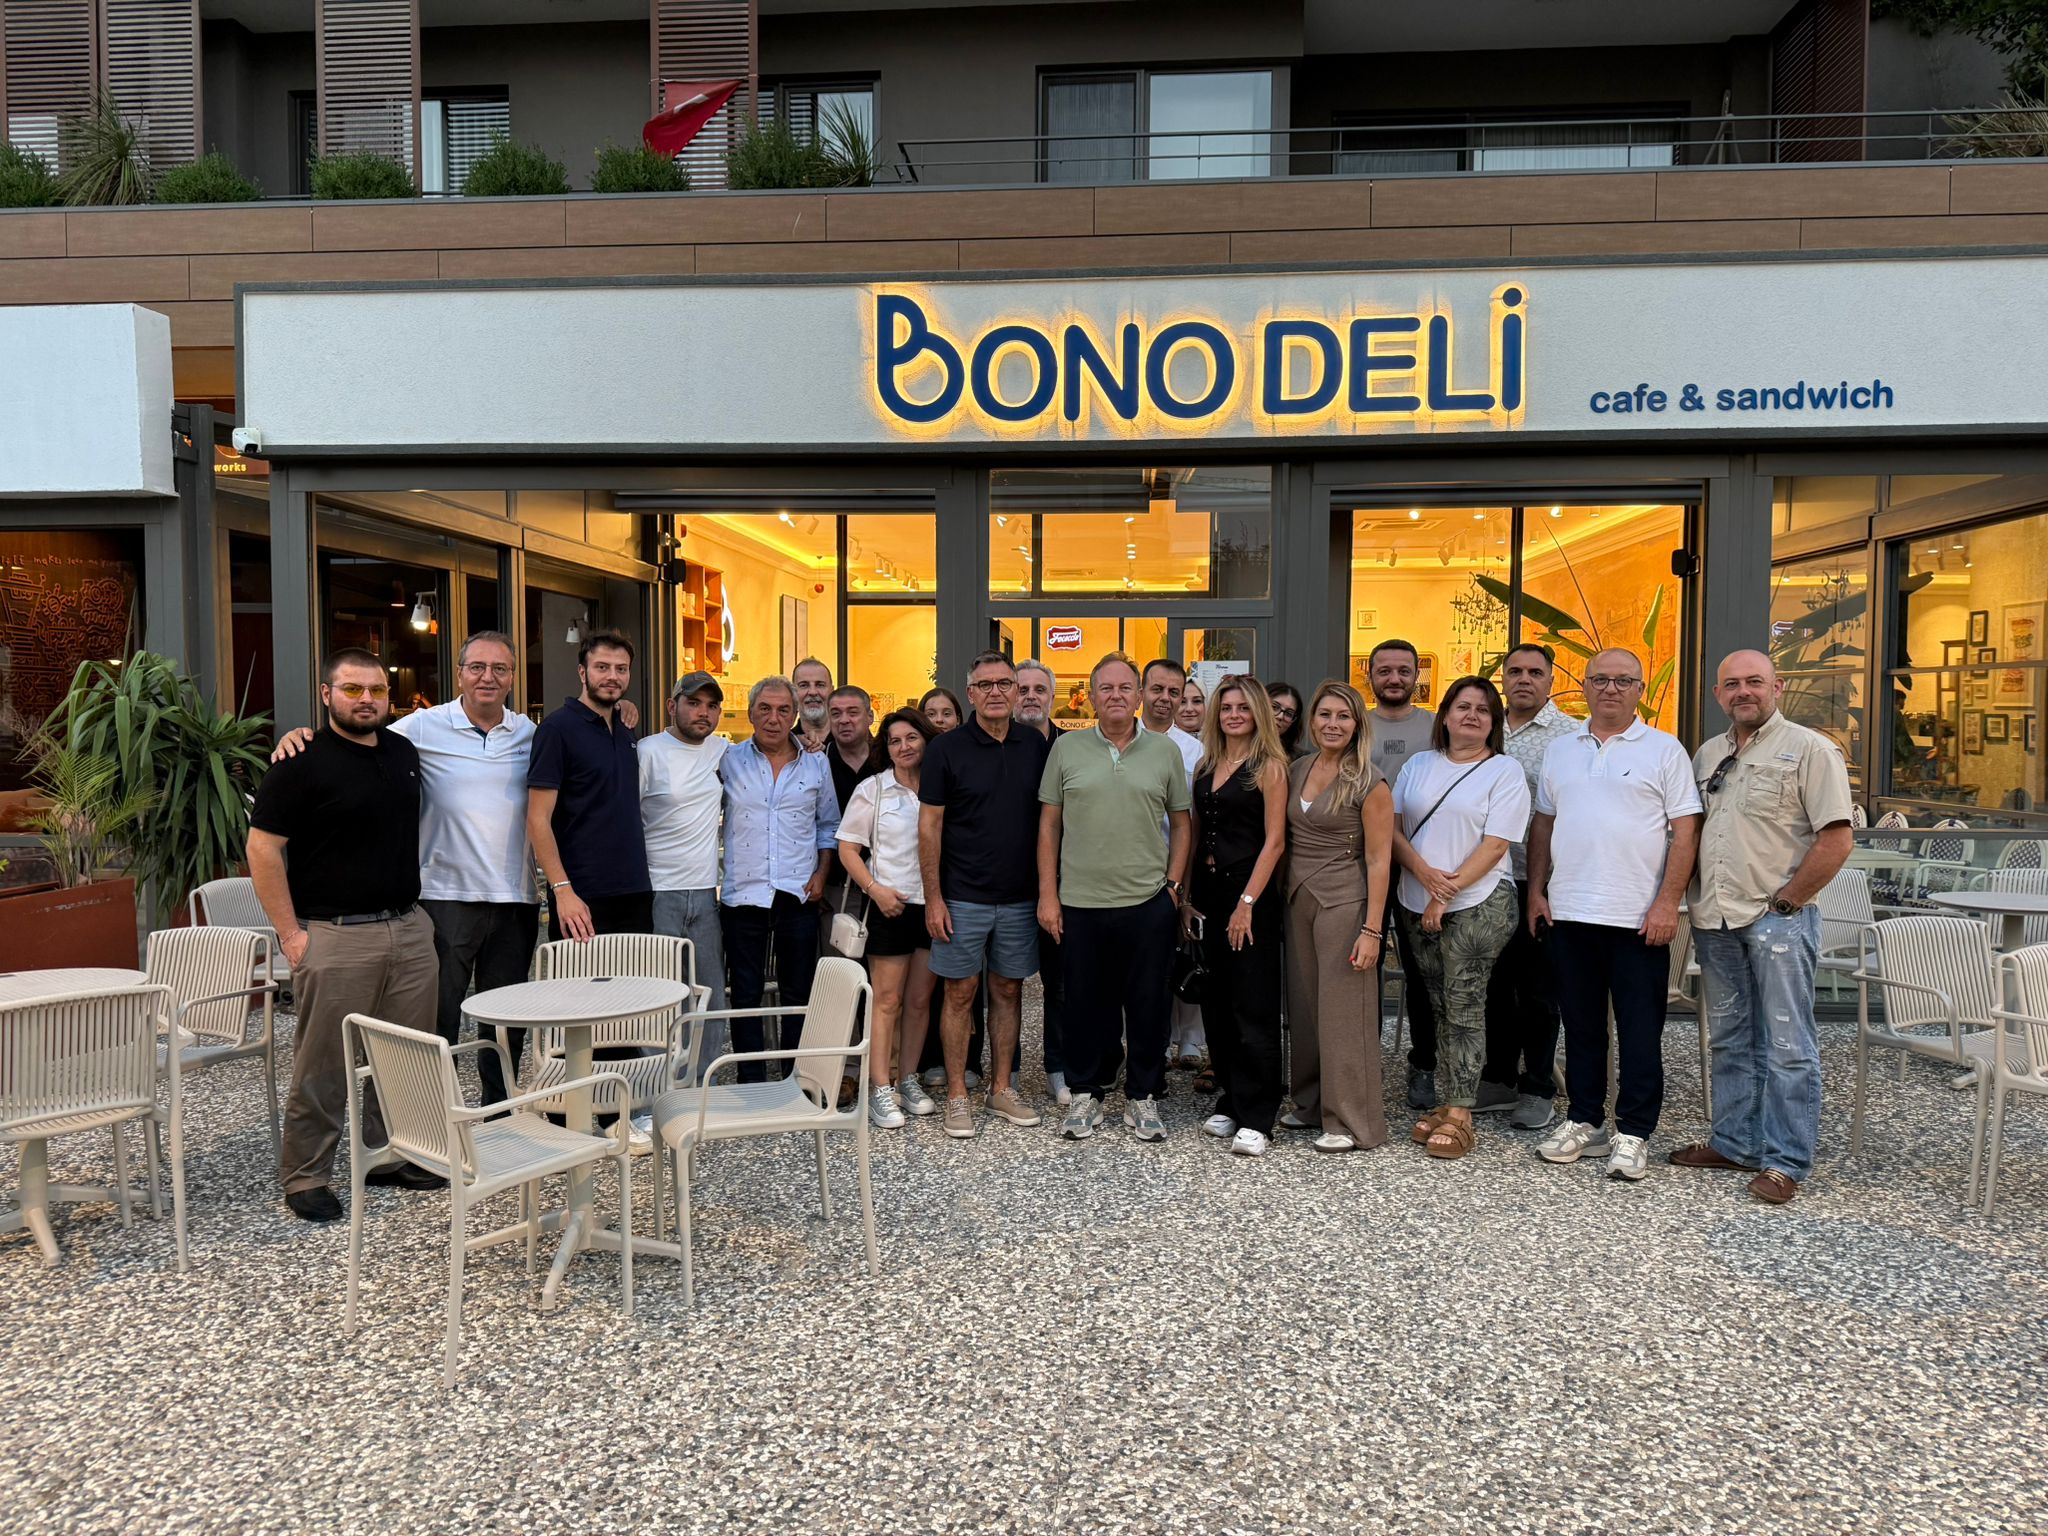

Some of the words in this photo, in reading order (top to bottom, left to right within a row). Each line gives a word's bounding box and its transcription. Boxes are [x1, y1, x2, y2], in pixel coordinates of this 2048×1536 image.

[877, 294, 1236, 423] BONO
[1590, 382, 1668, 413] cafe
[1679, 383, 1706, 412] &
[1717, 379, 1894, 412] sandwich
[213, 462, 247, 472] works
